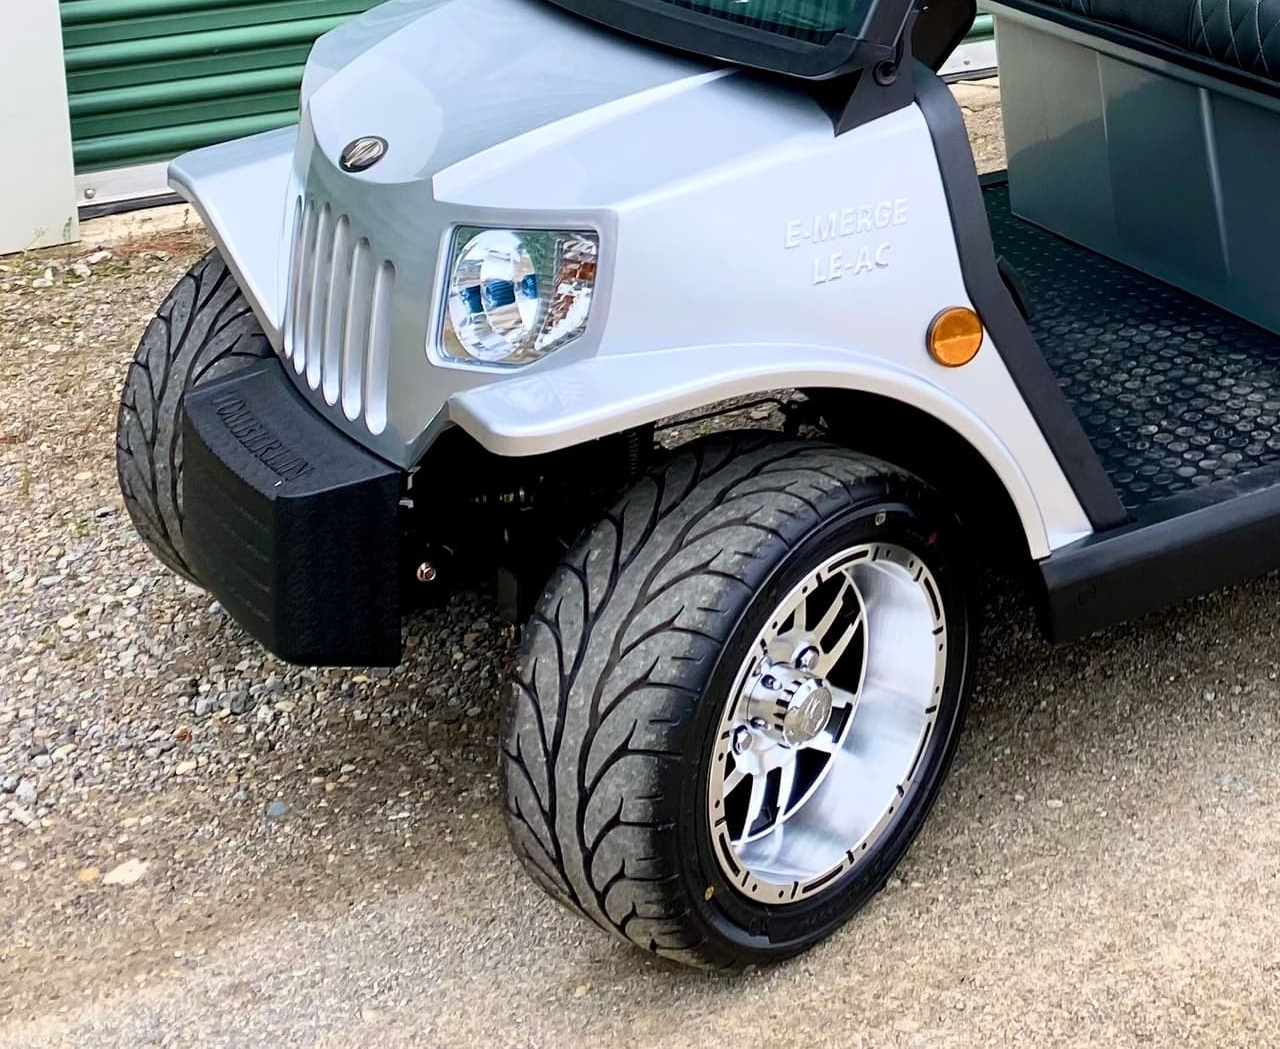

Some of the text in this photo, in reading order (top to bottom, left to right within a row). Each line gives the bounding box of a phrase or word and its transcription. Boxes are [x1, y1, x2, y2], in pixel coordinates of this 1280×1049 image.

[785, 199, 909, 249] E-MERGE
[813, 243, 891, 285] LE-AC
[213, 390, 317, 482] TOMBERLIN
